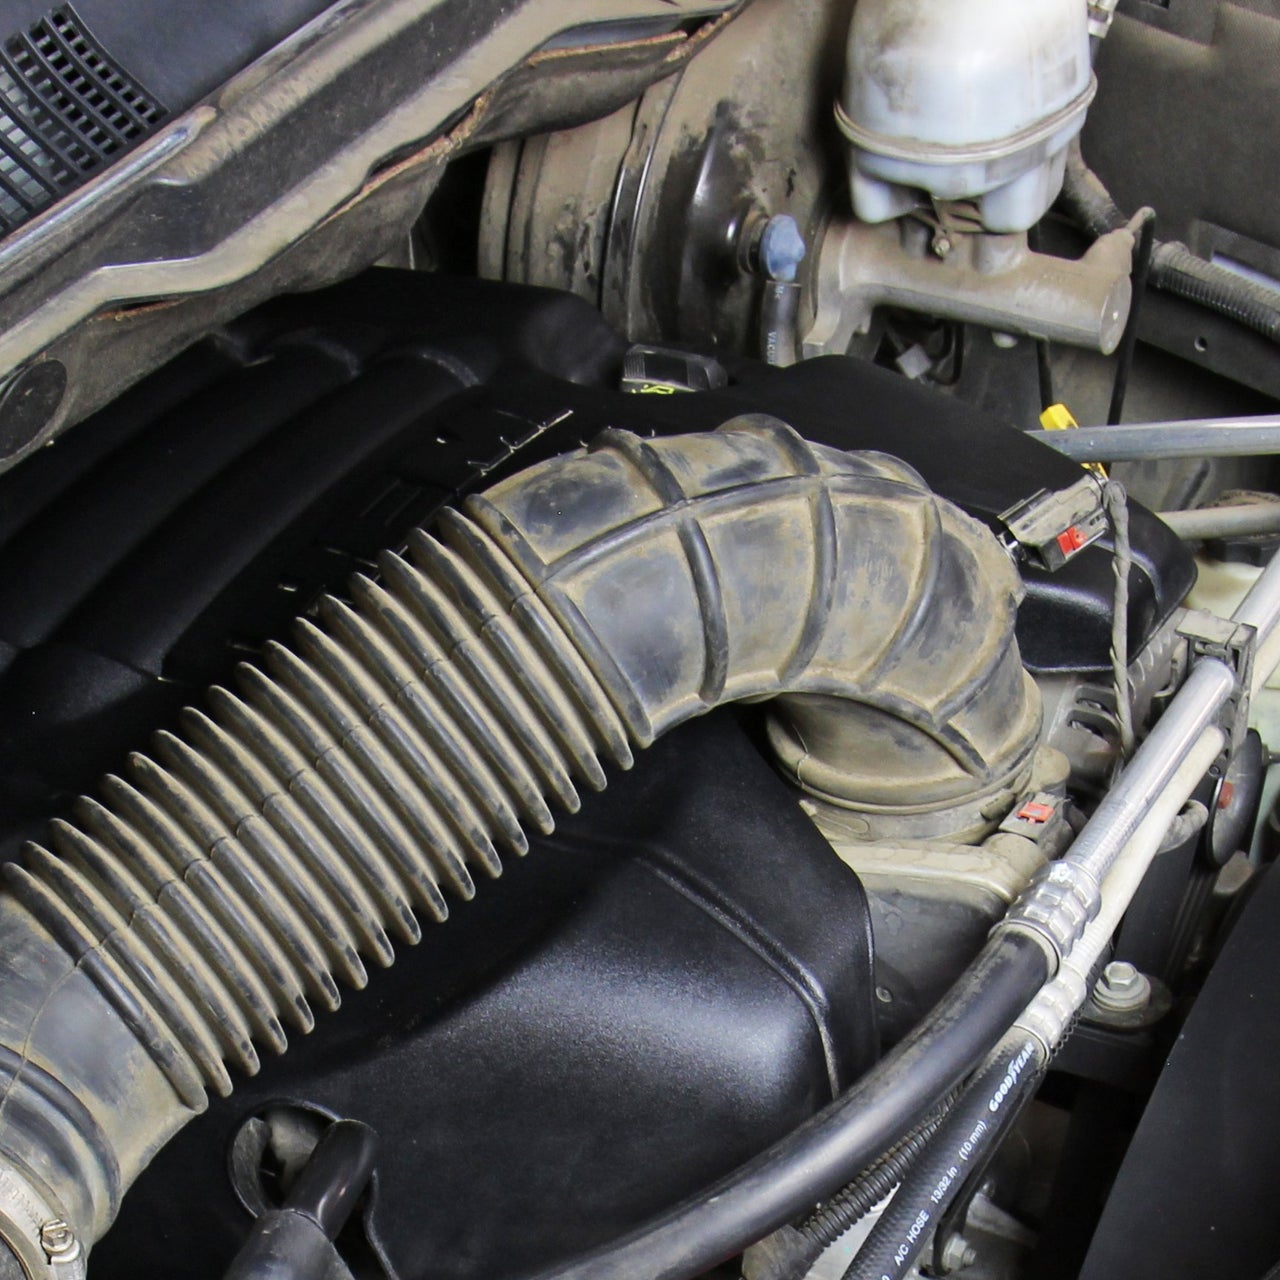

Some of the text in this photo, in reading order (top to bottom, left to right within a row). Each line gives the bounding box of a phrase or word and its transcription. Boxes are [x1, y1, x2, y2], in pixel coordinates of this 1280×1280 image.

[894, 1244, 910, 1266] A/C
[907, 1210, 930, 1243] HOSE
[931, 1176, 951, 1204] 13/32
[958, 1140, 973, 1161] (10
[968, 1120, 987, 1147] mm)
[989, 1042, 1035, 1113] GOODYEAR
